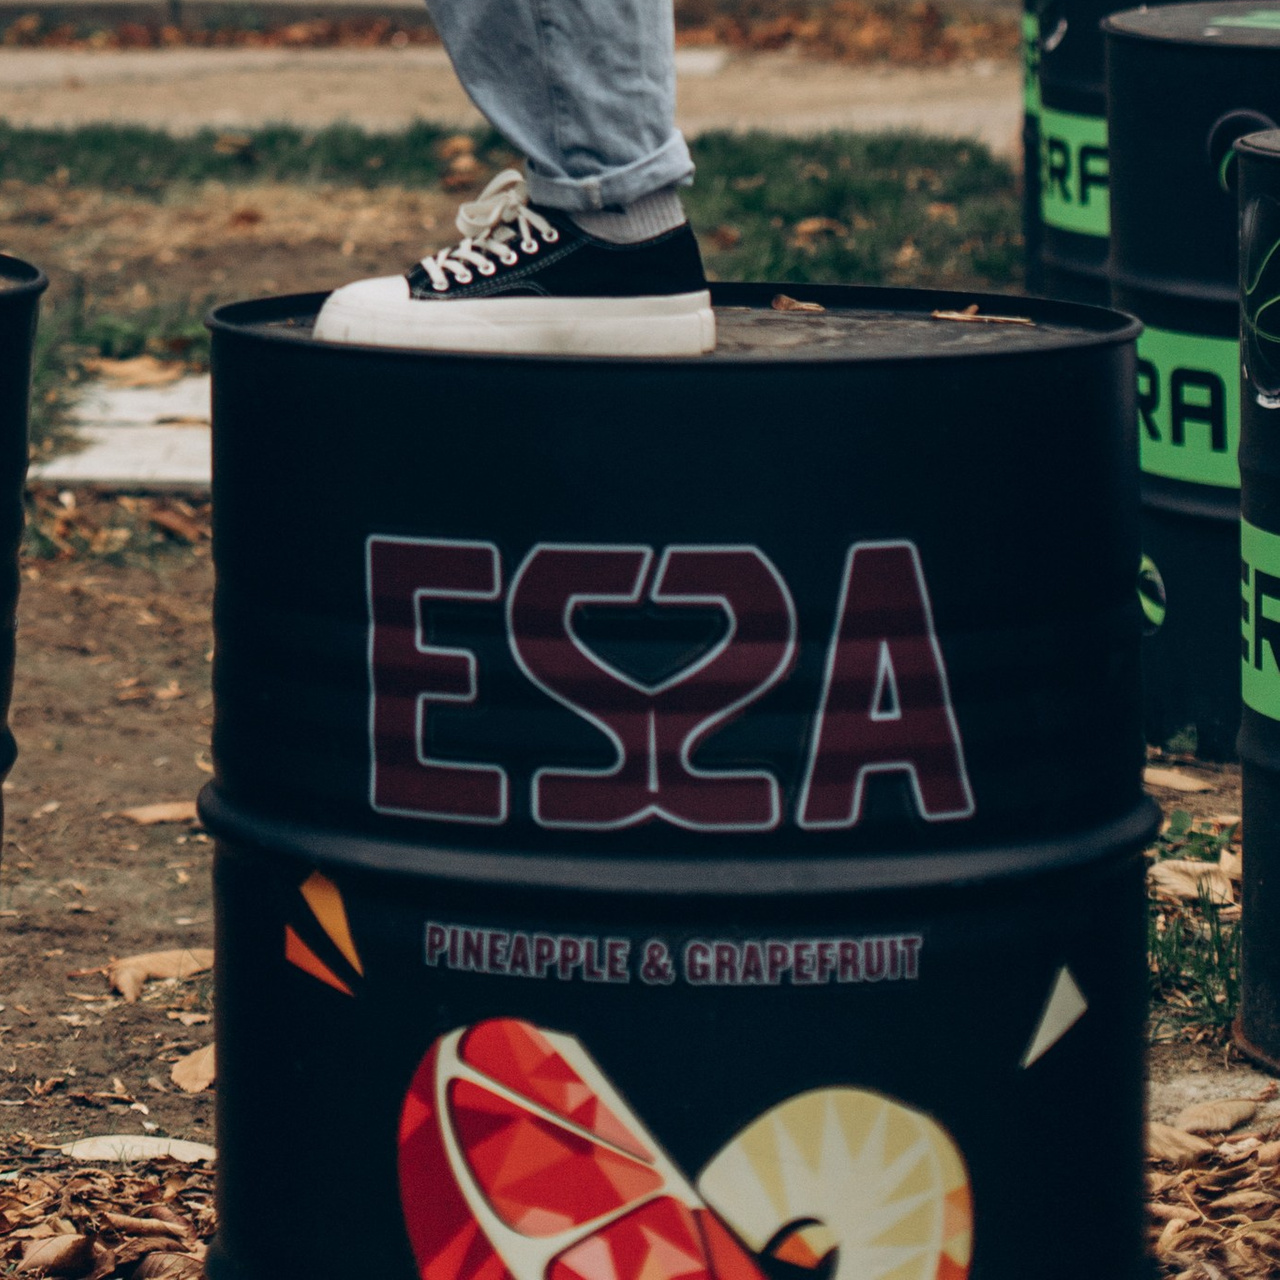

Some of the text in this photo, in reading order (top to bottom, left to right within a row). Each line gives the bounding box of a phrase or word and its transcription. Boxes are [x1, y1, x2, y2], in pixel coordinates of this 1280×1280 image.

[424, 921, 923, 987] PINEAPPLE & GRAPEFRUIT
